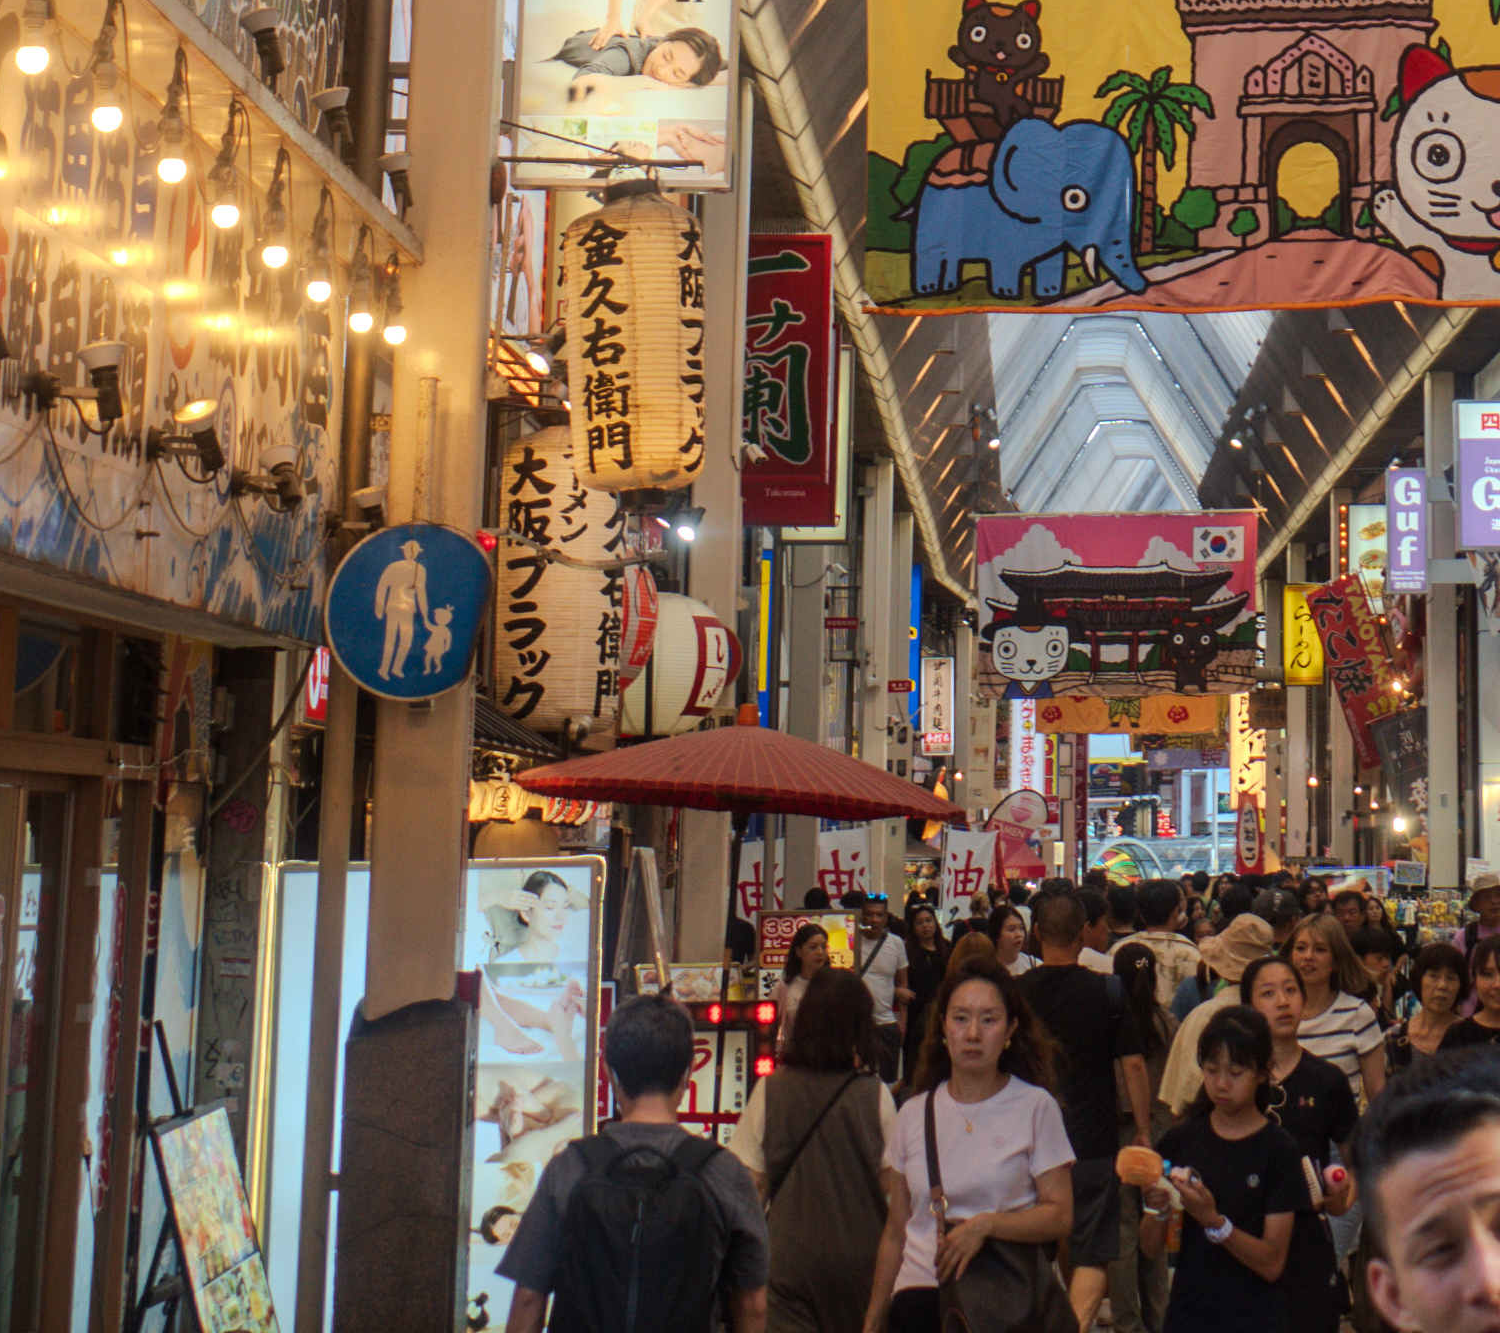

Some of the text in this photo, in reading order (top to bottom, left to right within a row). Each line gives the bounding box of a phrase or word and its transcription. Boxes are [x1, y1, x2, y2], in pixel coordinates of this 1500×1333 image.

[577, 220, 634, 474] 金久右衛門
[502, 445, 561, 721] 大阪ブラック
[1312, 591, 1375, 705] たこ焼
[943, 848, 987, 901] 油
